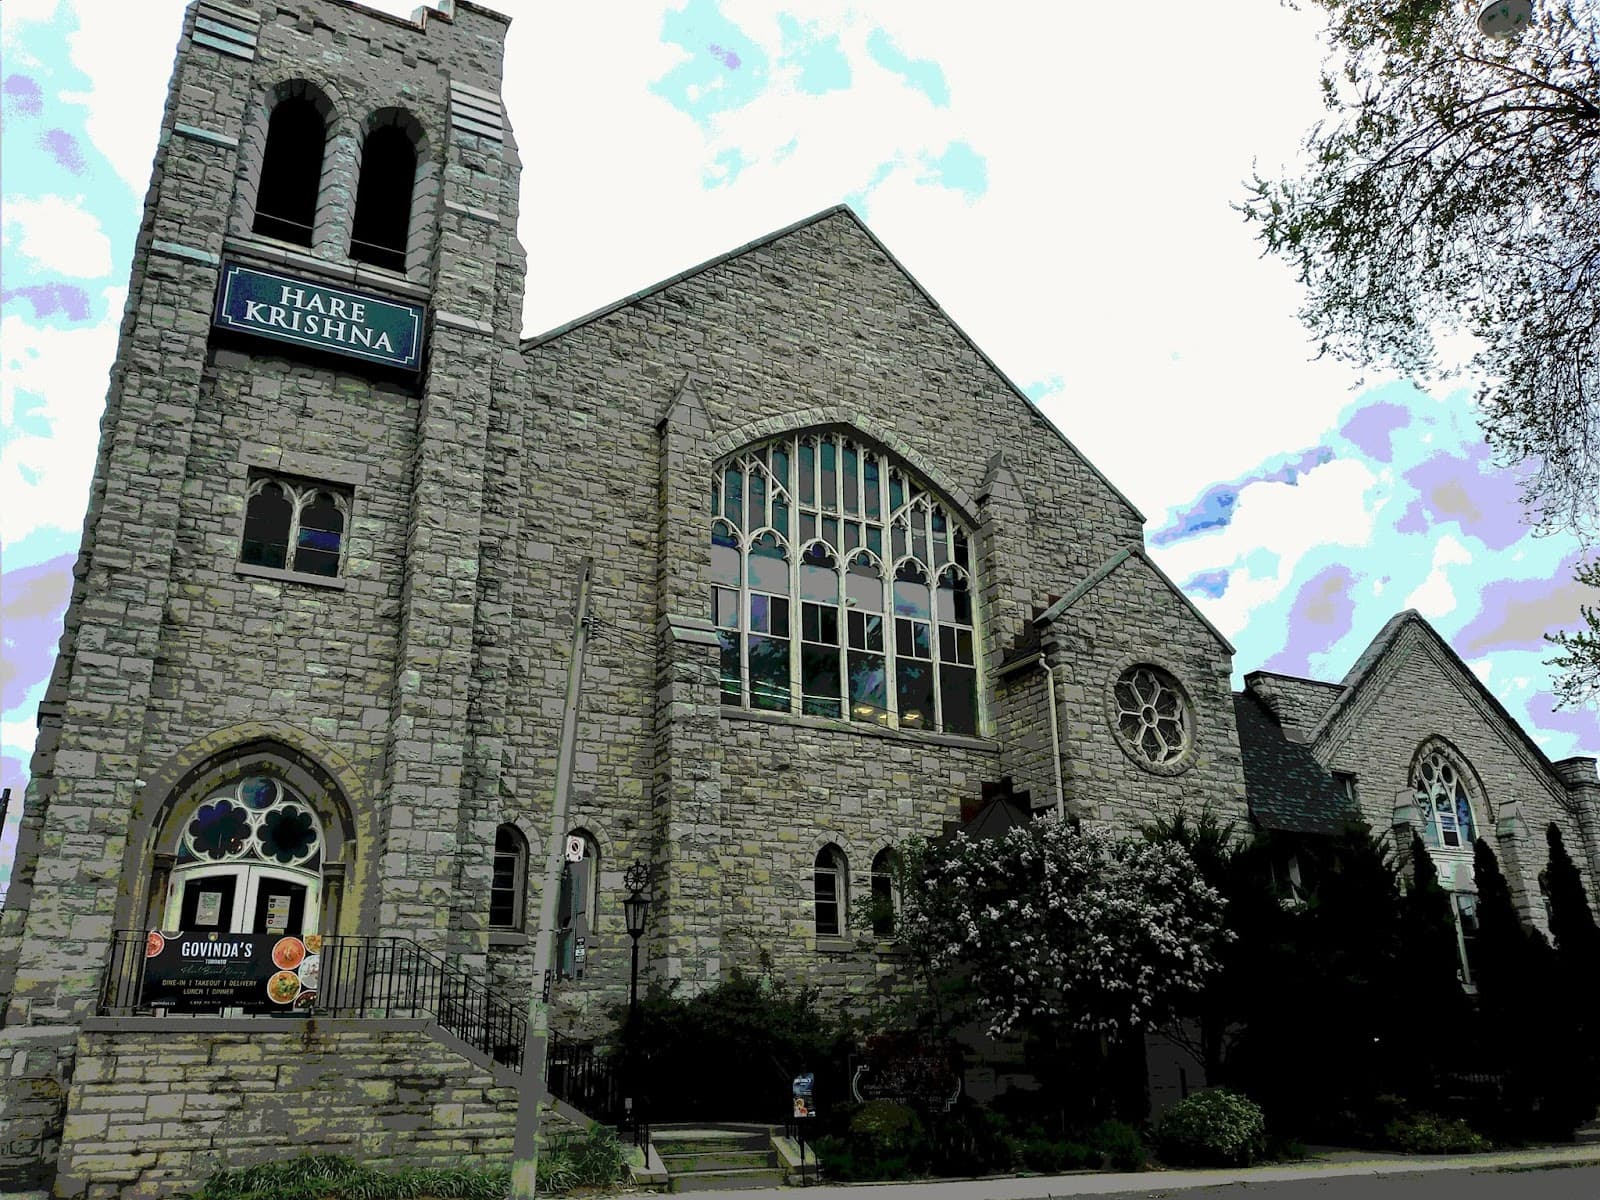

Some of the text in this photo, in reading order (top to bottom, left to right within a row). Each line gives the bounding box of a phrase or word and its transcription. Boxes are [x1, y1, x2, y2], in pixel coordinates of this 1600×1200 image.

[279, 285, 366, 323] HARE
[243, 300, 395, 353] KRISHNA
[181, 941, 253, 958] GOVINDA'S
[162, 979, 257, 988] DINE-IN TAKEOUT DELIVERY
[183, 988, 234, 996] LUNCH DINNER
